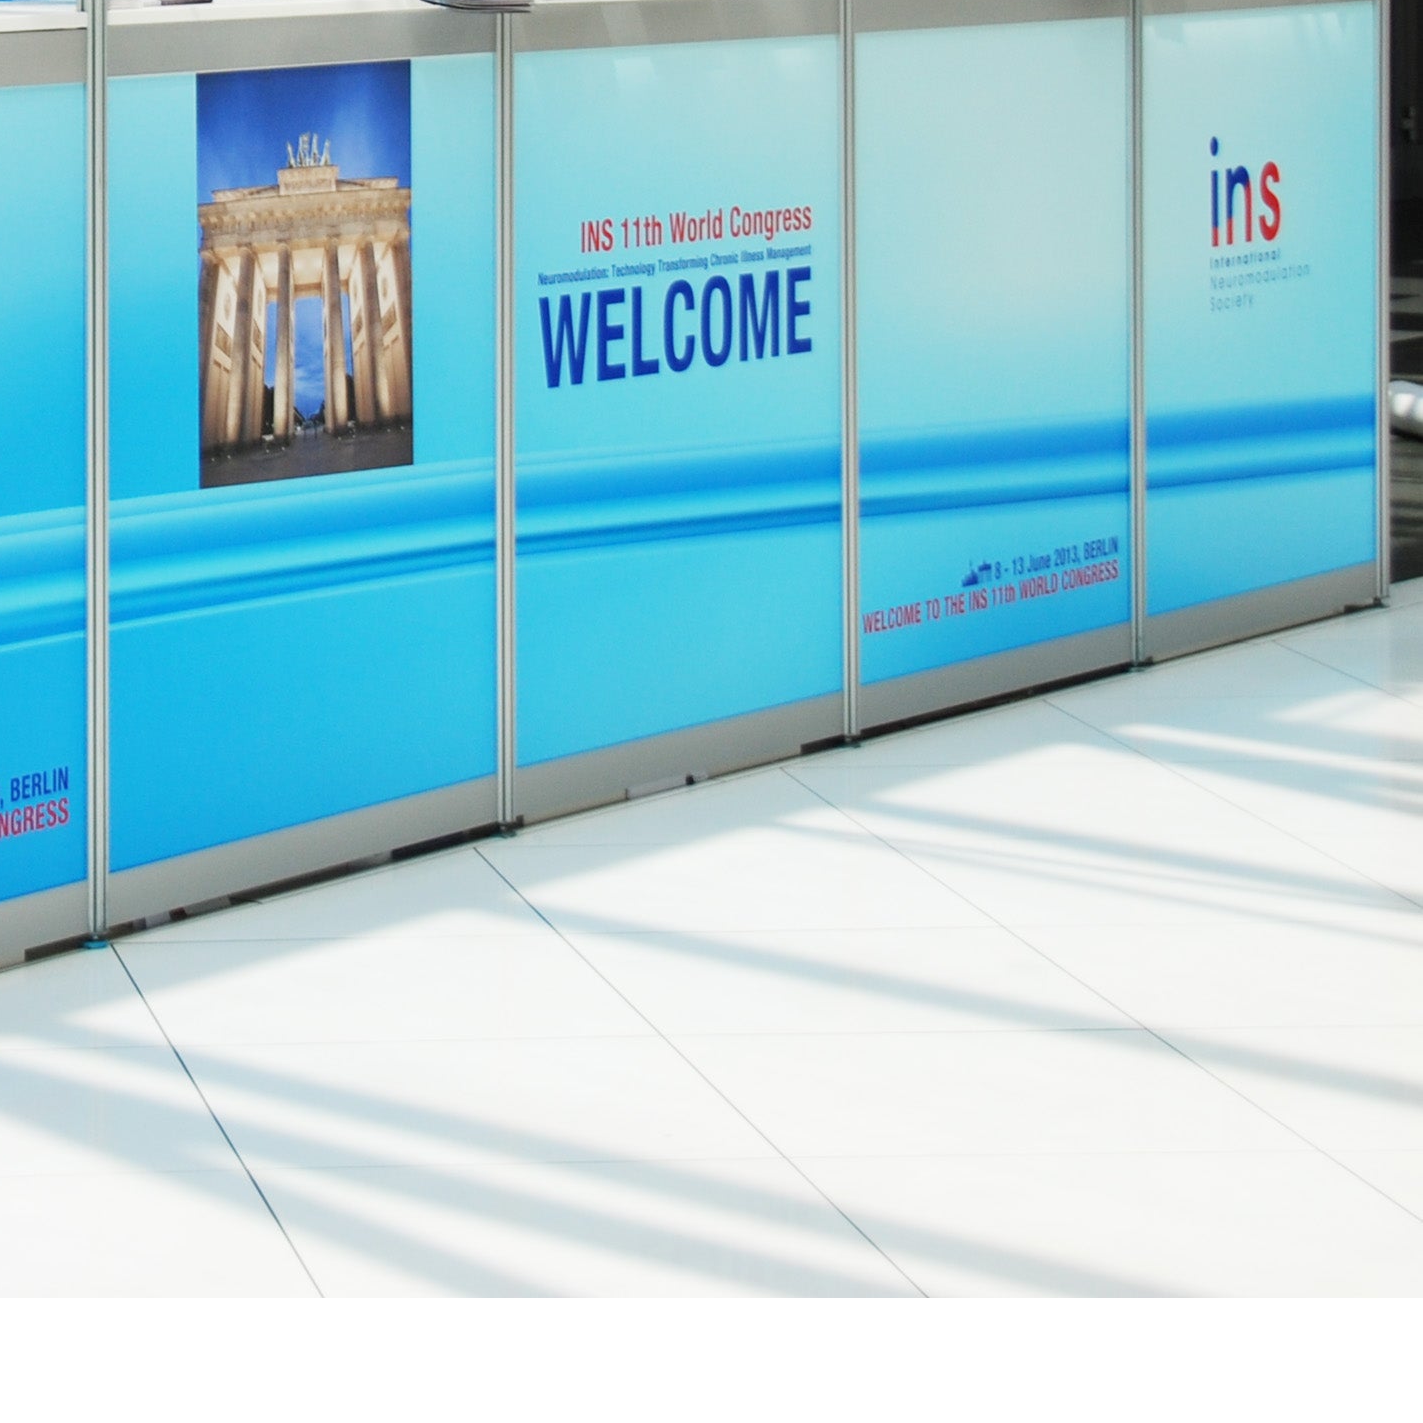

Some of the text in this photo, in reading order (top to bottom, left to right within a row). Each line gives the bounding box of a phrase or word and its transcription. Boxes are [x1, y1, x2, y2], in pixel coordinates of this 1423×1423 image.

[1210, 136, 1281, 247] ins
[581, 205, 812, 254] INS 11th World Congress
[611, 261, 655, 277] Technology
[658, 255, 708, 272] Transforming
[710, 251, 739, 266] Chronic
[766, 244, 812, 262] Management
[1210, 248, 1281, 269] International
[1210, 263, 1310, 290] Neuromodulation
[538, 266, 812, 389] WELCOME
[994, 561, 1002, 580] 8
[1012, 556, 1024, 576] 13
[1026, 553, 1051, 573] June
[1083, 535, 1119, 560] BERLIN
[863, 559, 1119, 633] WELCOME TO THE INS 11th WORLD CONGRESS
[10, 766, 70, 803] BERLIN
